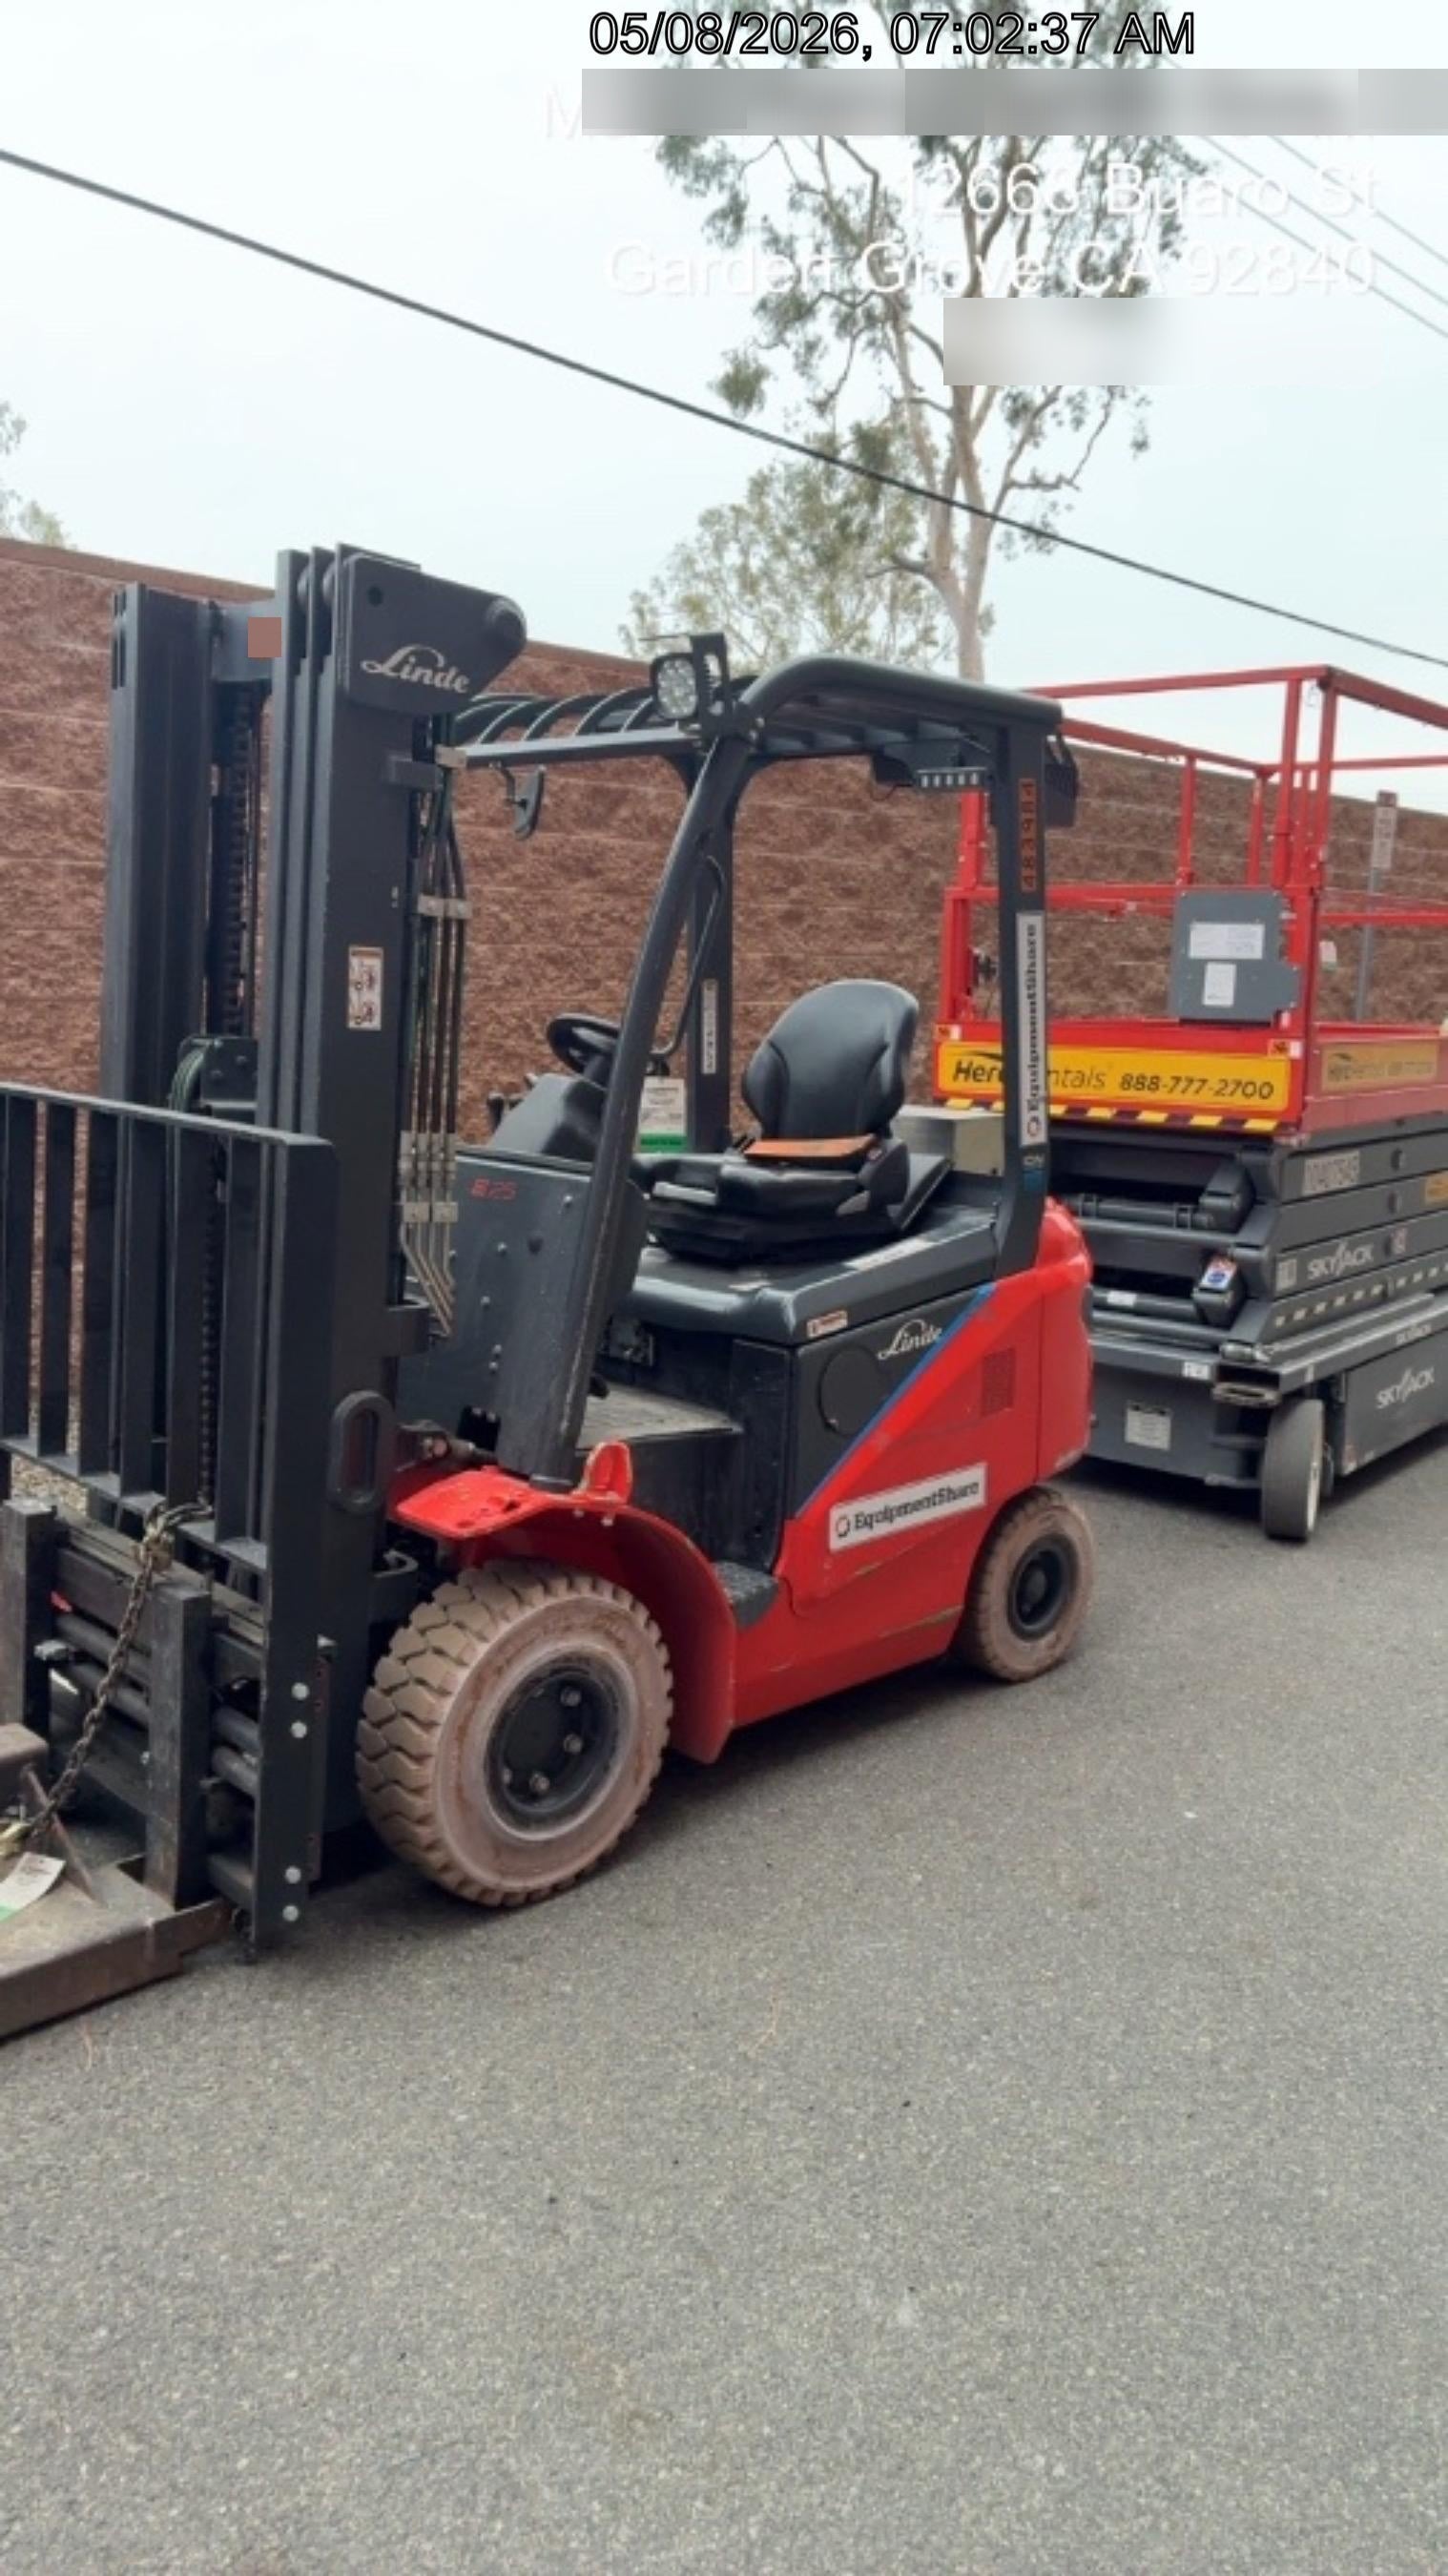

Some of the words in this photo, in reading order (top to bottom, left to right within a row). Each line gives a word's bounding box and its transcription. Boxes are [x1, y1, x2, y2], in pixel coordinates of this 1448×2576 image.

[360, 644, 469, 694] Linde
[1119, 1072, 1274, 1101] 888-777-2700
[877, 1319, 943, 1361] Linde
[854, 1481, 981, 1530] EquipmentShare
